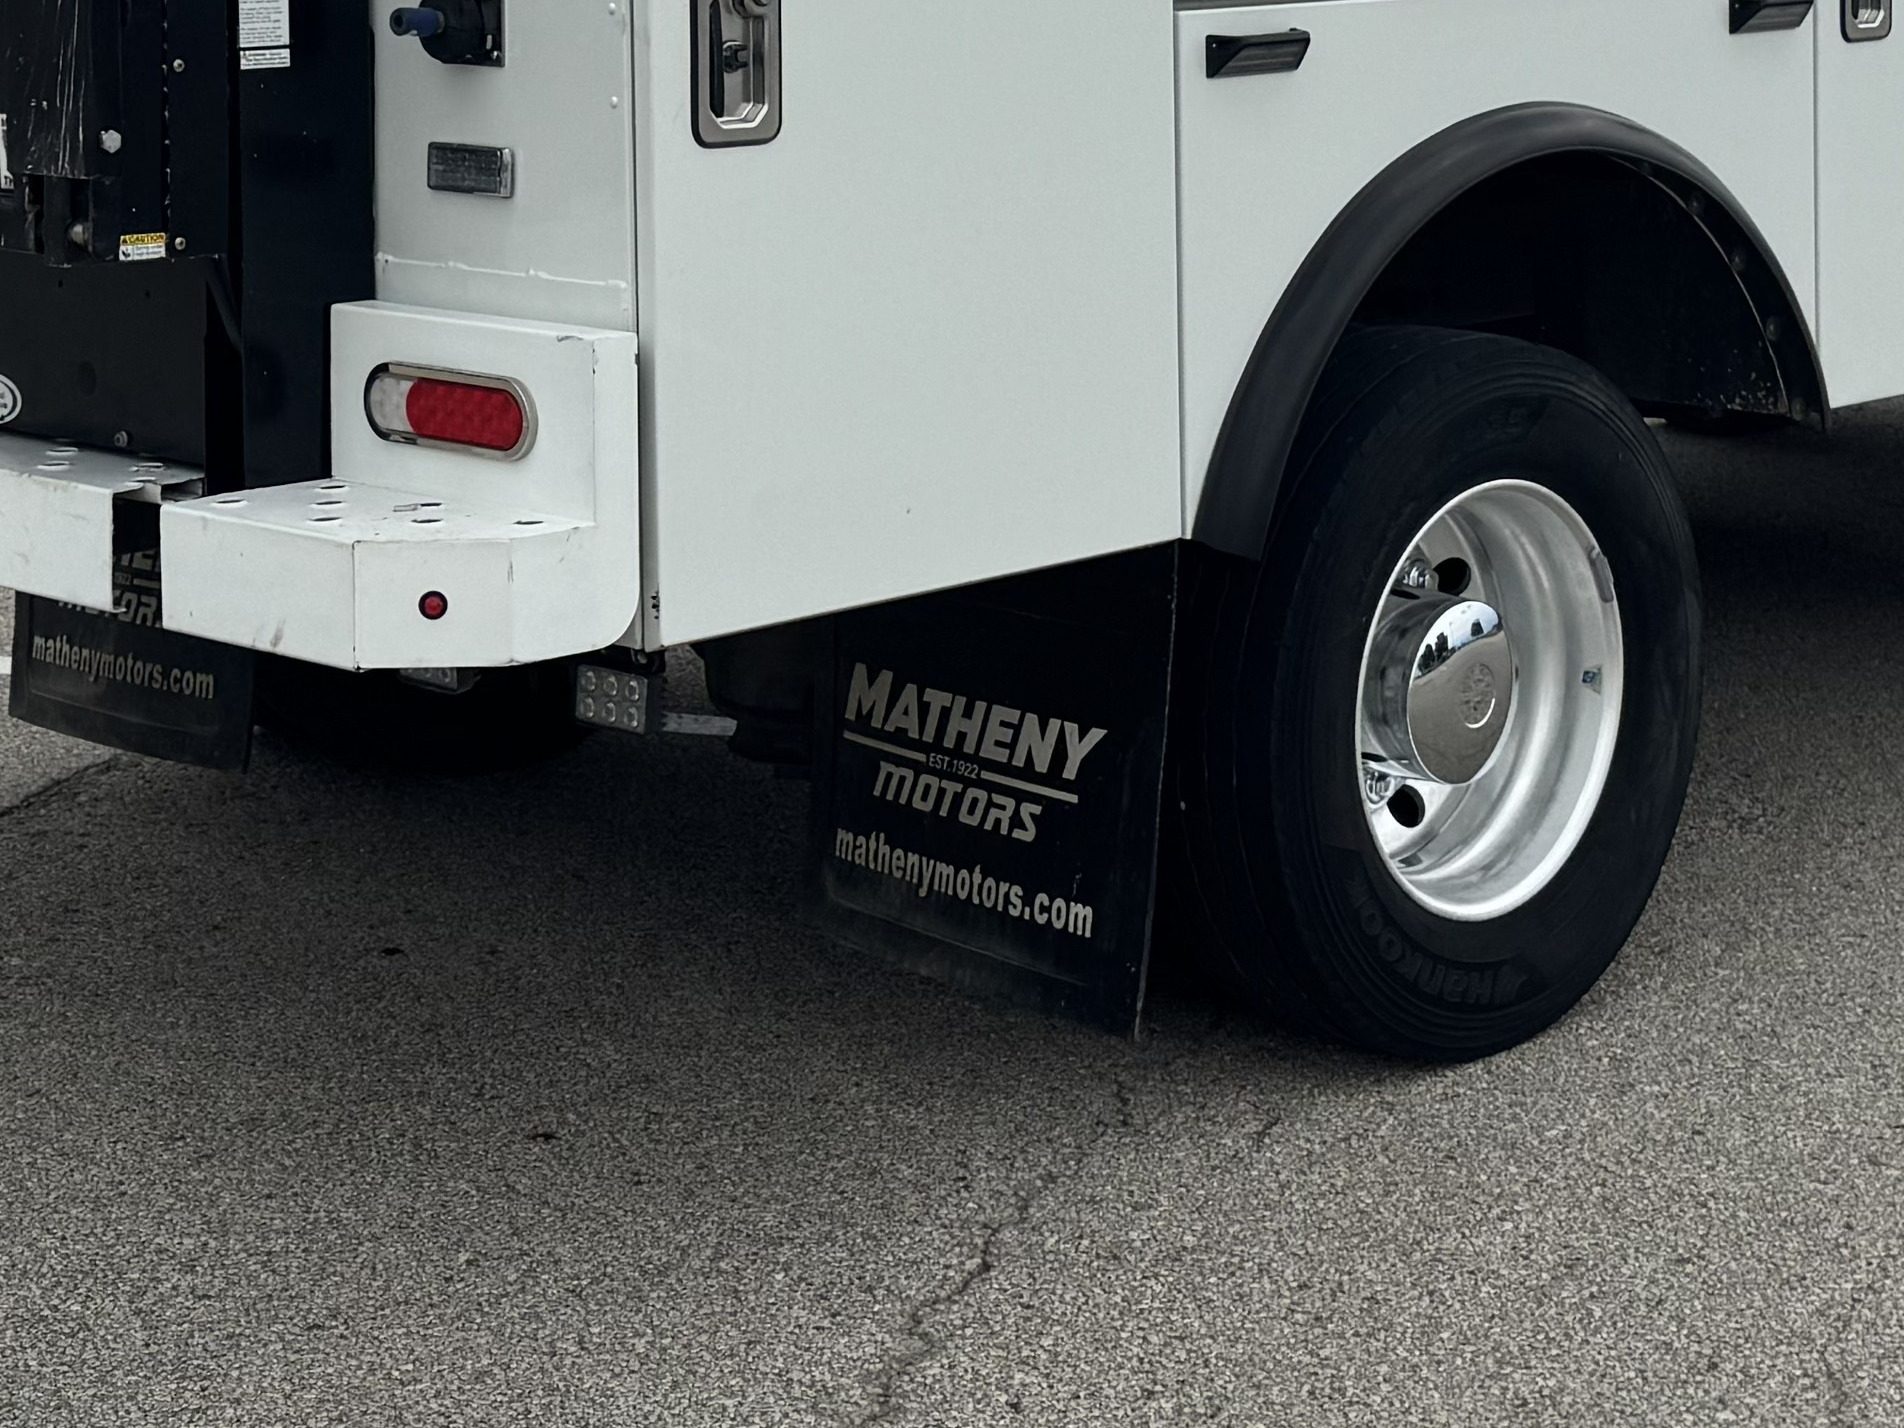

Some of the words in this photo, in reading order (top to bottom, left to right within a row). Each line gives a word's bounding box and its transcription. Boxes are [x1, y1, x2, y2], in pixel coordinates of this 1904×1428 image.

[128, 233, 164, 244] CAUTION
[32, 634, 214, 699] mathenymotors.com
[844, 662, 1109, 780] MATHENY
[873, 760, 1043, 843] MOTORS
[835, 826, 1093, 939] mathenymotors.com
